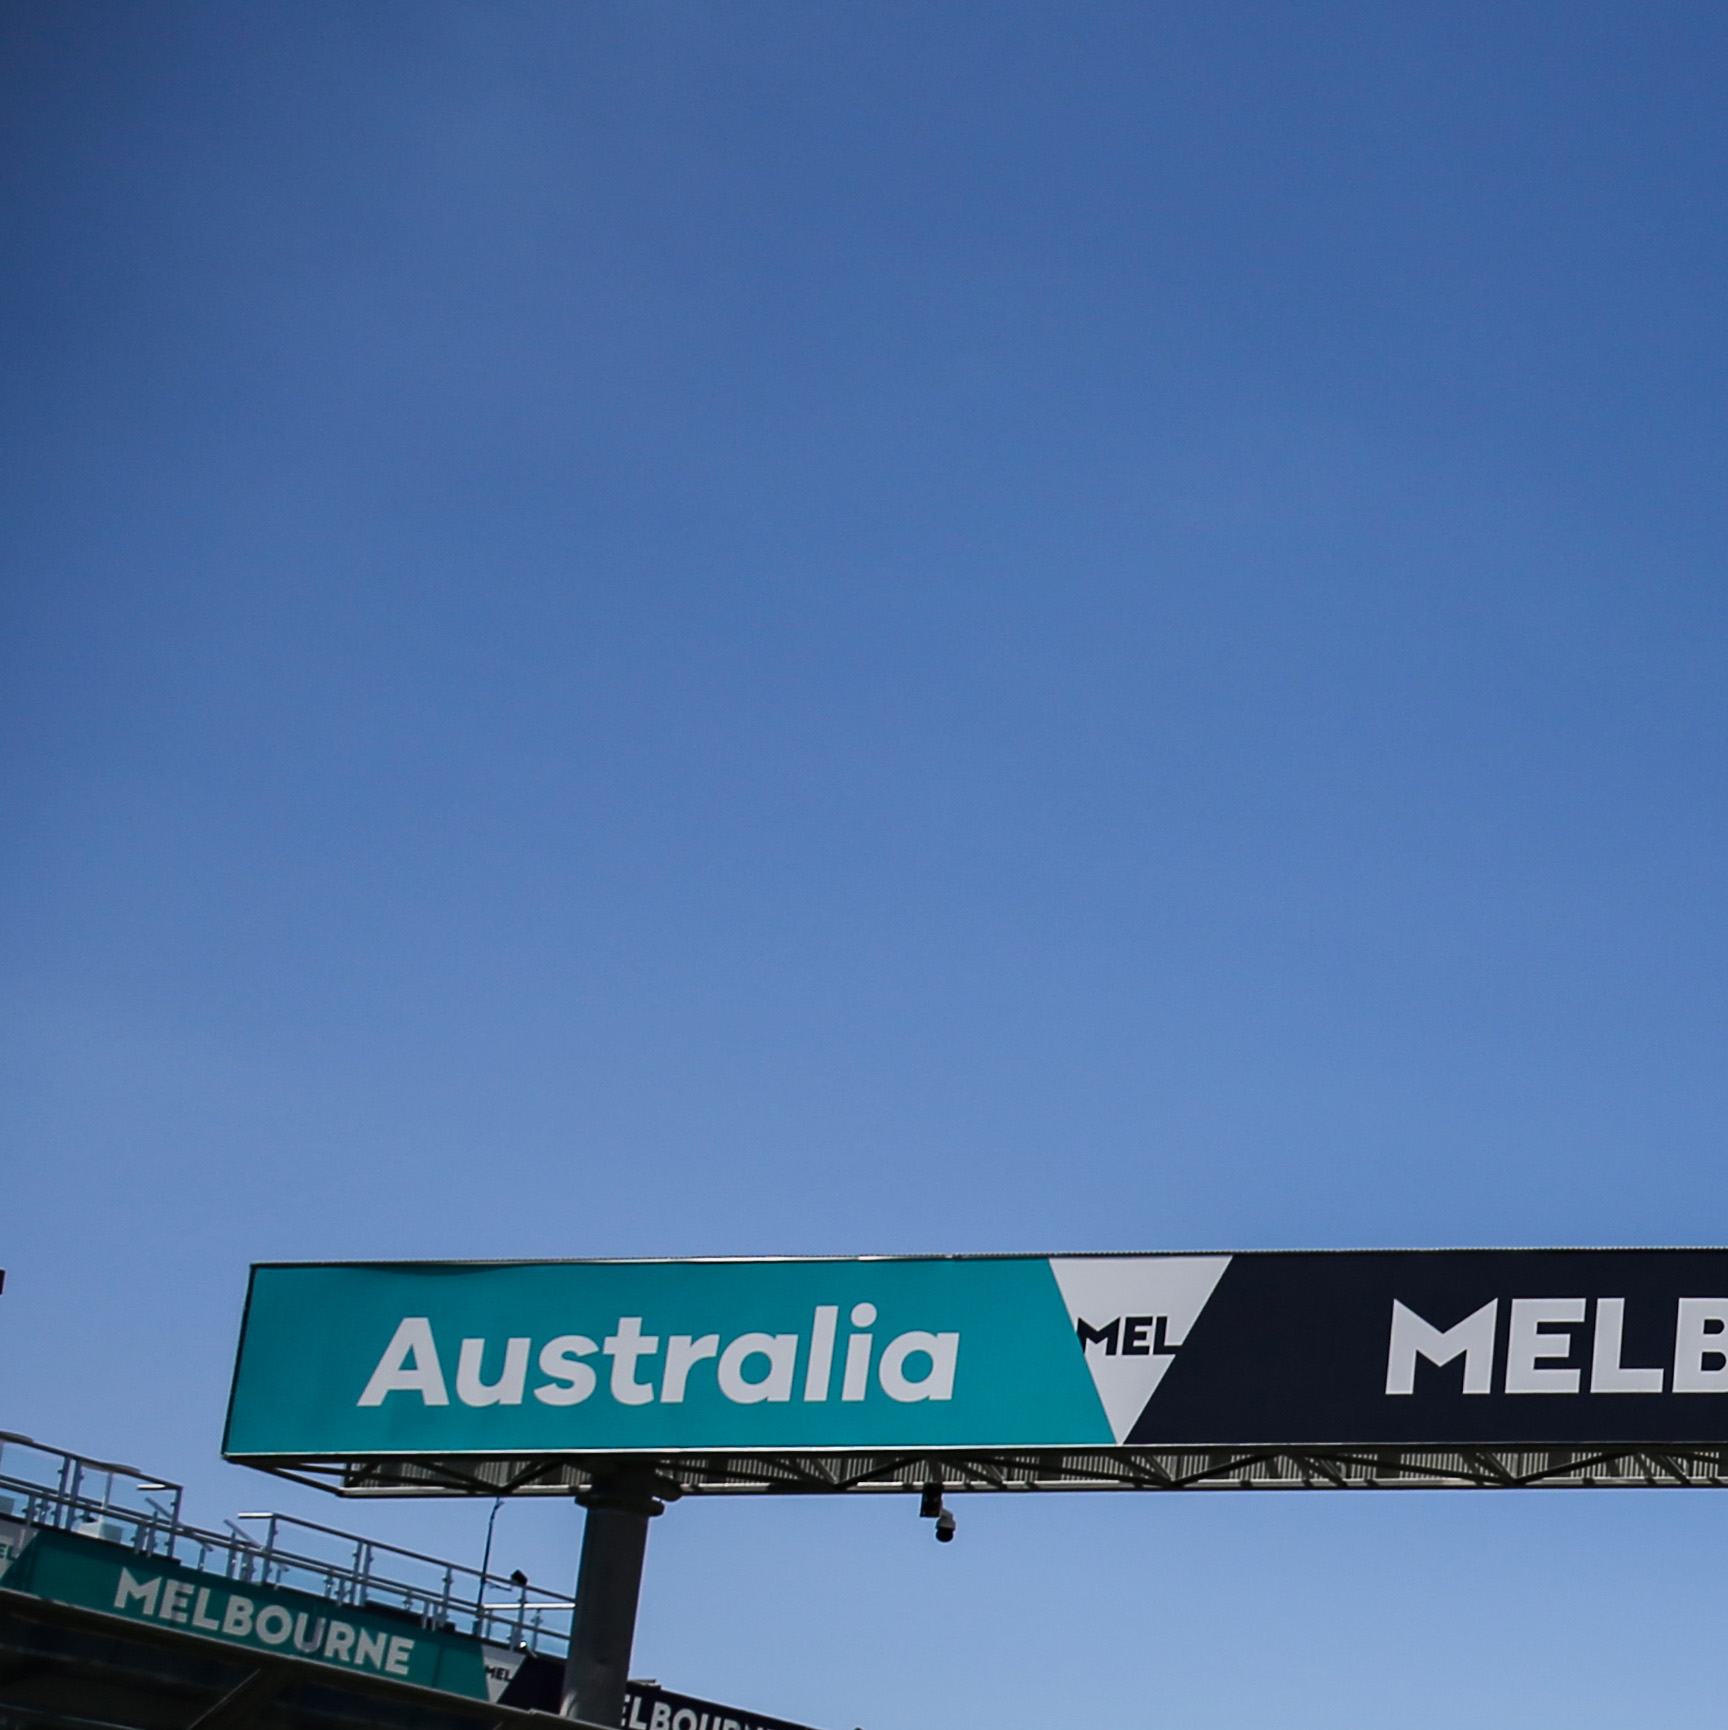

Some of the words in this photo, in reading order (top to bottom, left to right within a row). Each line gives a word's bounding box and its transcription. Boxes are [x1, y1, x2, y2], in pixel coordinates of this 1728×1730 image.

[357, 1302, 960, 1406] Australia
[1074, 1314, 1183, 1357] MEL
[113, 1567, 414, 1676] MELBOURNE
[484, 1664, 513, 1682] MEL
